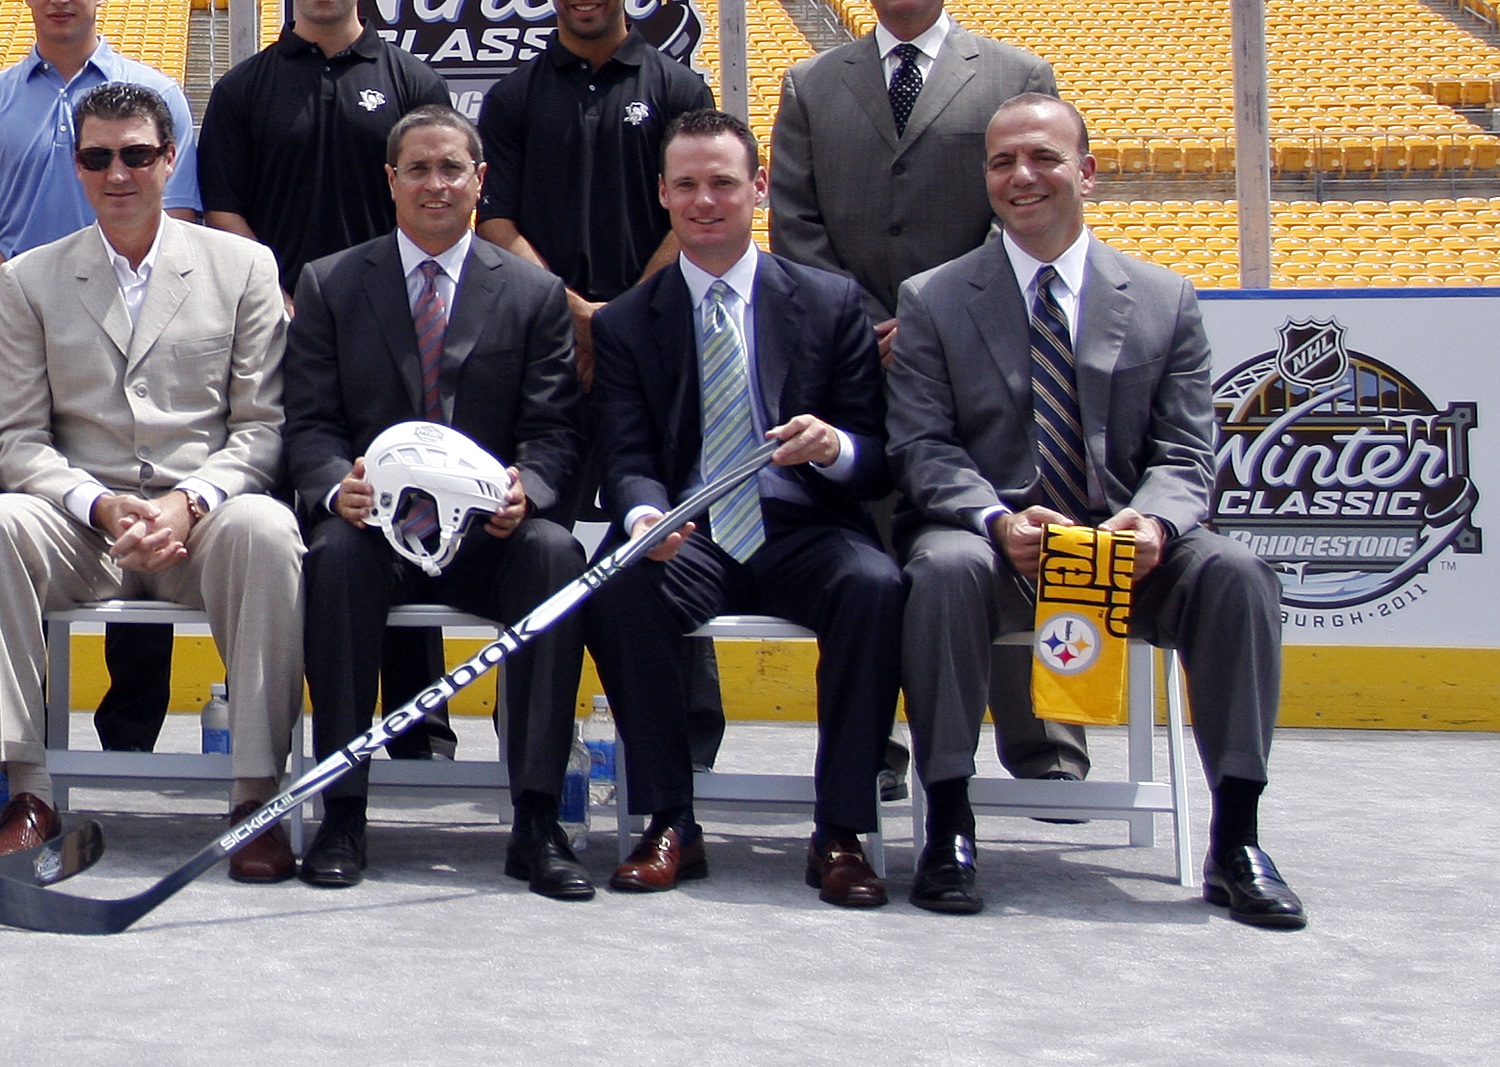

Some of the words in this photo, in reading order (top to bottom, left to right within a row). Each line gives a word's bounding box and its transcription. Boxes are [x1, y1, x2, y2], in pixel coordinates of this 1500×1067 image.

[376, 27, 557, 62] LASS
[1291, 335, 1337, 374] NHL
[1212, 384, 1446, 488] Winter
[1217, 490, 1422, 516] CLASSIC
[1438, 560, 1457, 571] TM
[1378, 583, 1428, 617] 2011
[343, 617, 542, 767] Reebok
[220, 801, 283, 851] SICKICK
